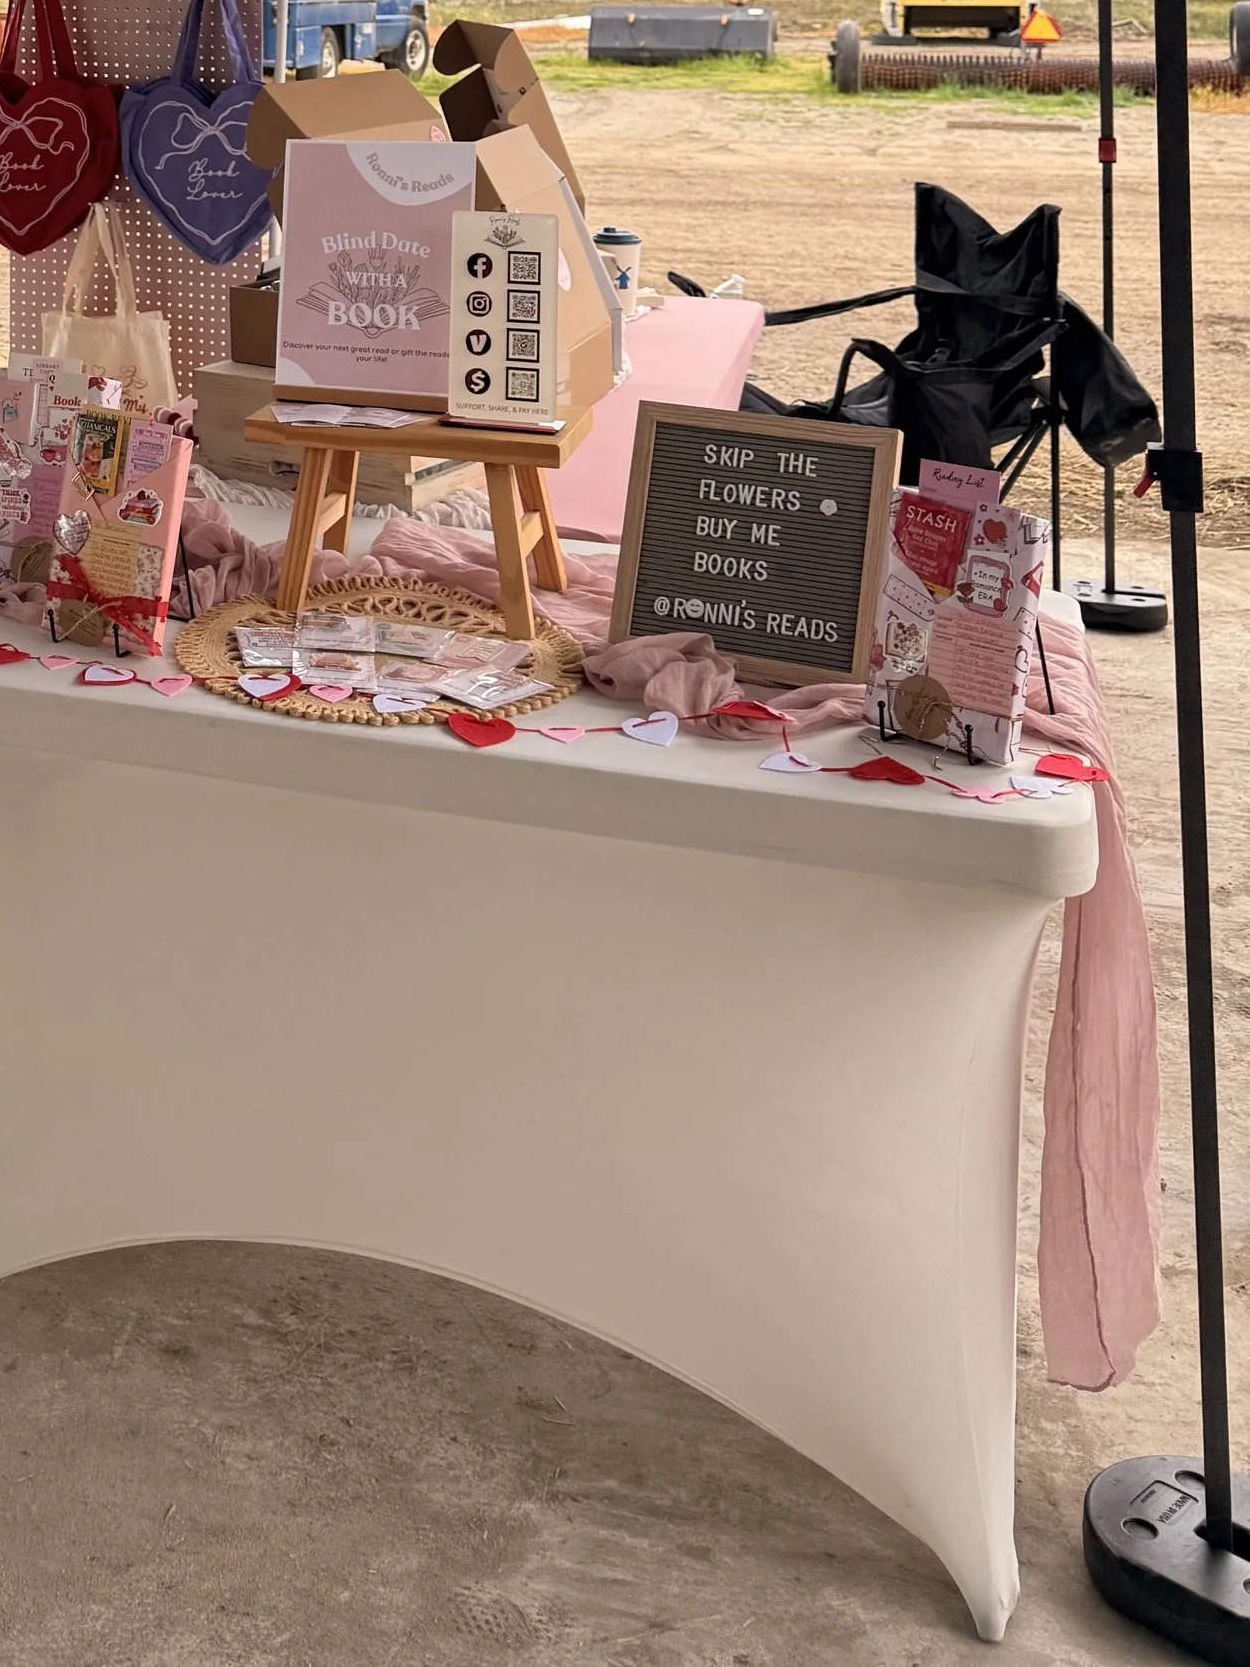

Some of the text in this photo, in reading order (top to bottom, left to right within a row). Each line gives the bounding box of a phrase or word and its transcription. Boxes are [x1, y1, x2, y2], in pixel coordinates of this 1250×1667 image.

[188, 157, 240, 180] Book
[366, 152, 455, 193] Ronni's Reads
[186, 179, 244, 201] Lover
[321, 231, 431, 259] Blind Date
[346, 271, 408, 288] WITH A
[328, 301, 421, 331] BOOK
[283, 340, 314, 350] Discover
[315, 343, 332, 352] your
[333, 343, 350, 352] next
[351, 345, 371, 355] great
[372, 346, 390, 355] read
[400, 347, 414, 358] gift
[414, 348, 428, 357] the
[429, 349, 451, 358] reade
[355, 354, 388, 364] your life!
[49, 375, 56, 384] Q
[53, 395, 82, 407] Book
[123, 395, 148, 414] My
[456, 402, 549, 416] SUPPORT, SHARE, & PAY HERE
[703, 444, 819, 477] SKIP THE
[932, 468, 986, 489] Reading List
[699, 479, 801, 512] FLOWERS
[906, 505, 958, 533] STASH
[696, 515, 782, 547] BUY ME
[693, 551, 768, 582] BOOKS
[989, 572, 1000, 583] my
[977, 592, 994, 601] ERA
[766, 612, 839, 643] READS
